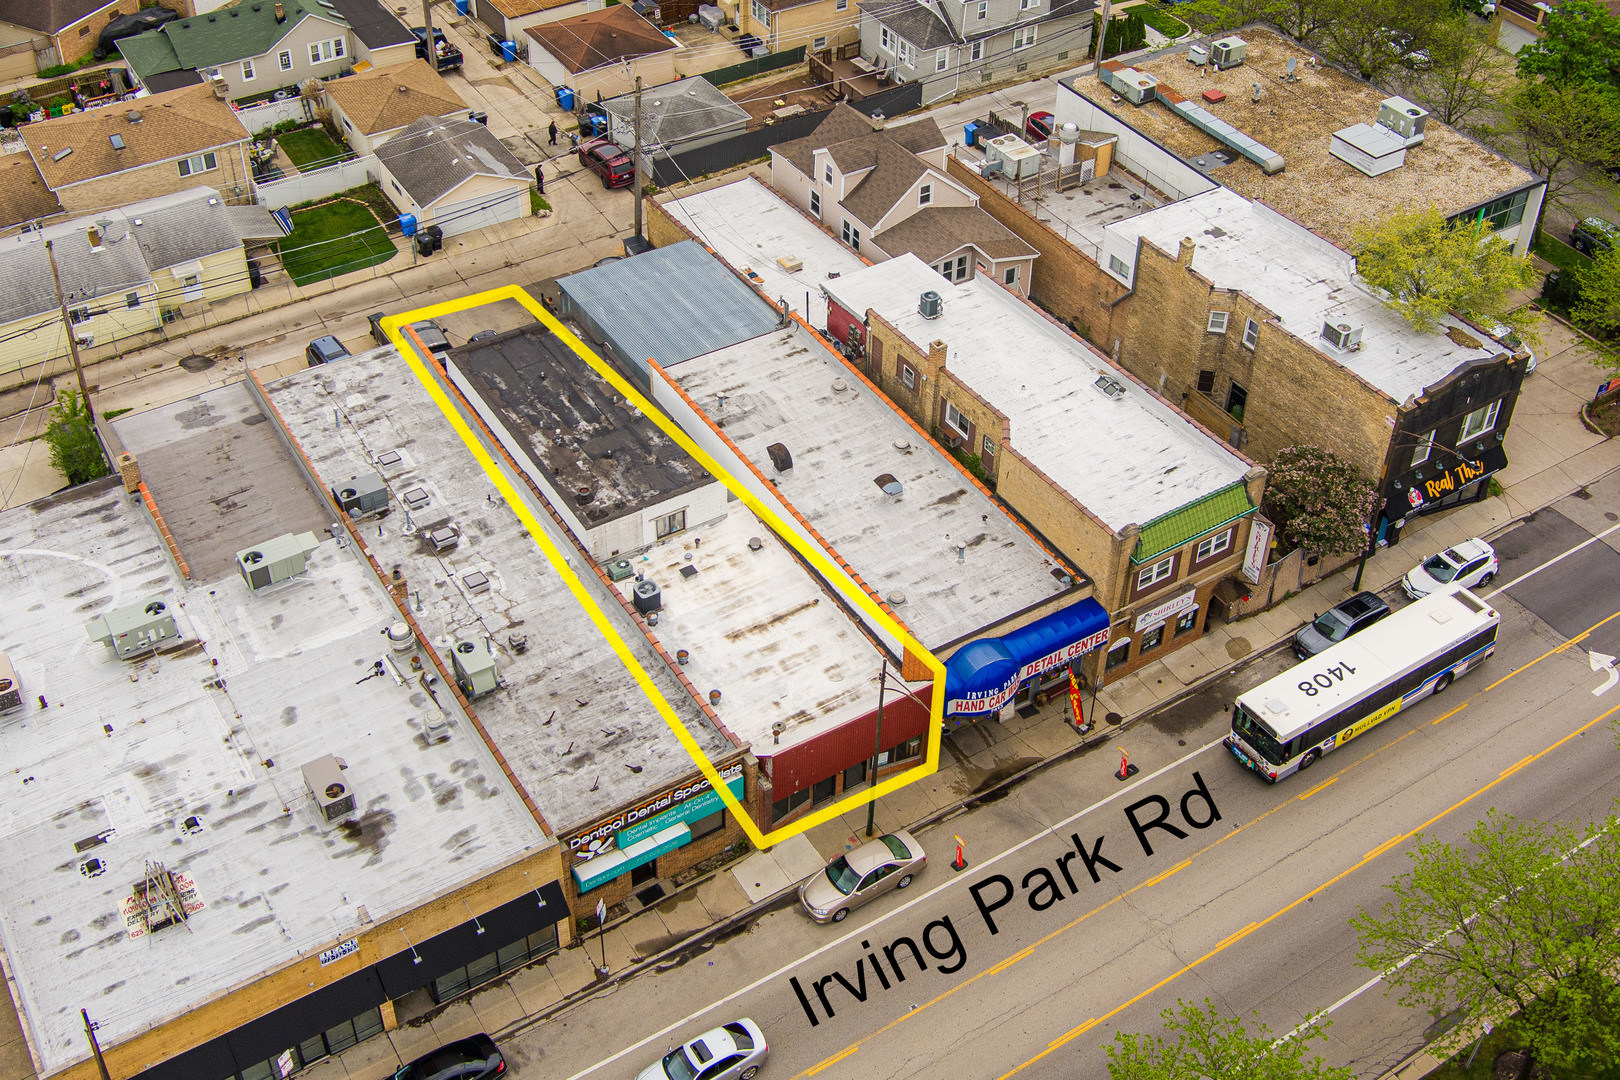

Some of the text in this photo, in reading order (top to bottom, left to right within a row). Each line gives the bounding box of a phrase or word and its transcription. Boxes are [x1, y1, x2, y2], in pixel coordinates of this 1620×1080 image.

[1425, 470, 1454, 498] Real
[1026, 629, 1109, 677] DETAIL CENTER
[967, 672, 1018, 700] IRVING PARK
[1297, 661, 1357, 697] 1408
[955, 699, 986, 712] HAND
[988, 691, 1007, 709] CAR
[1353, 705, 1396, 733] MULLVAD VPN
[570, 816, 625, 850] Dentpol
[627, 794, 671, 823] Dental
[626, 823, 648, 837] Dental
[648, 810, 677, 827] Implants
[627, 796, 720, 842] Cosmetic General Dentistry
[130, 928, 144, 939] 625
